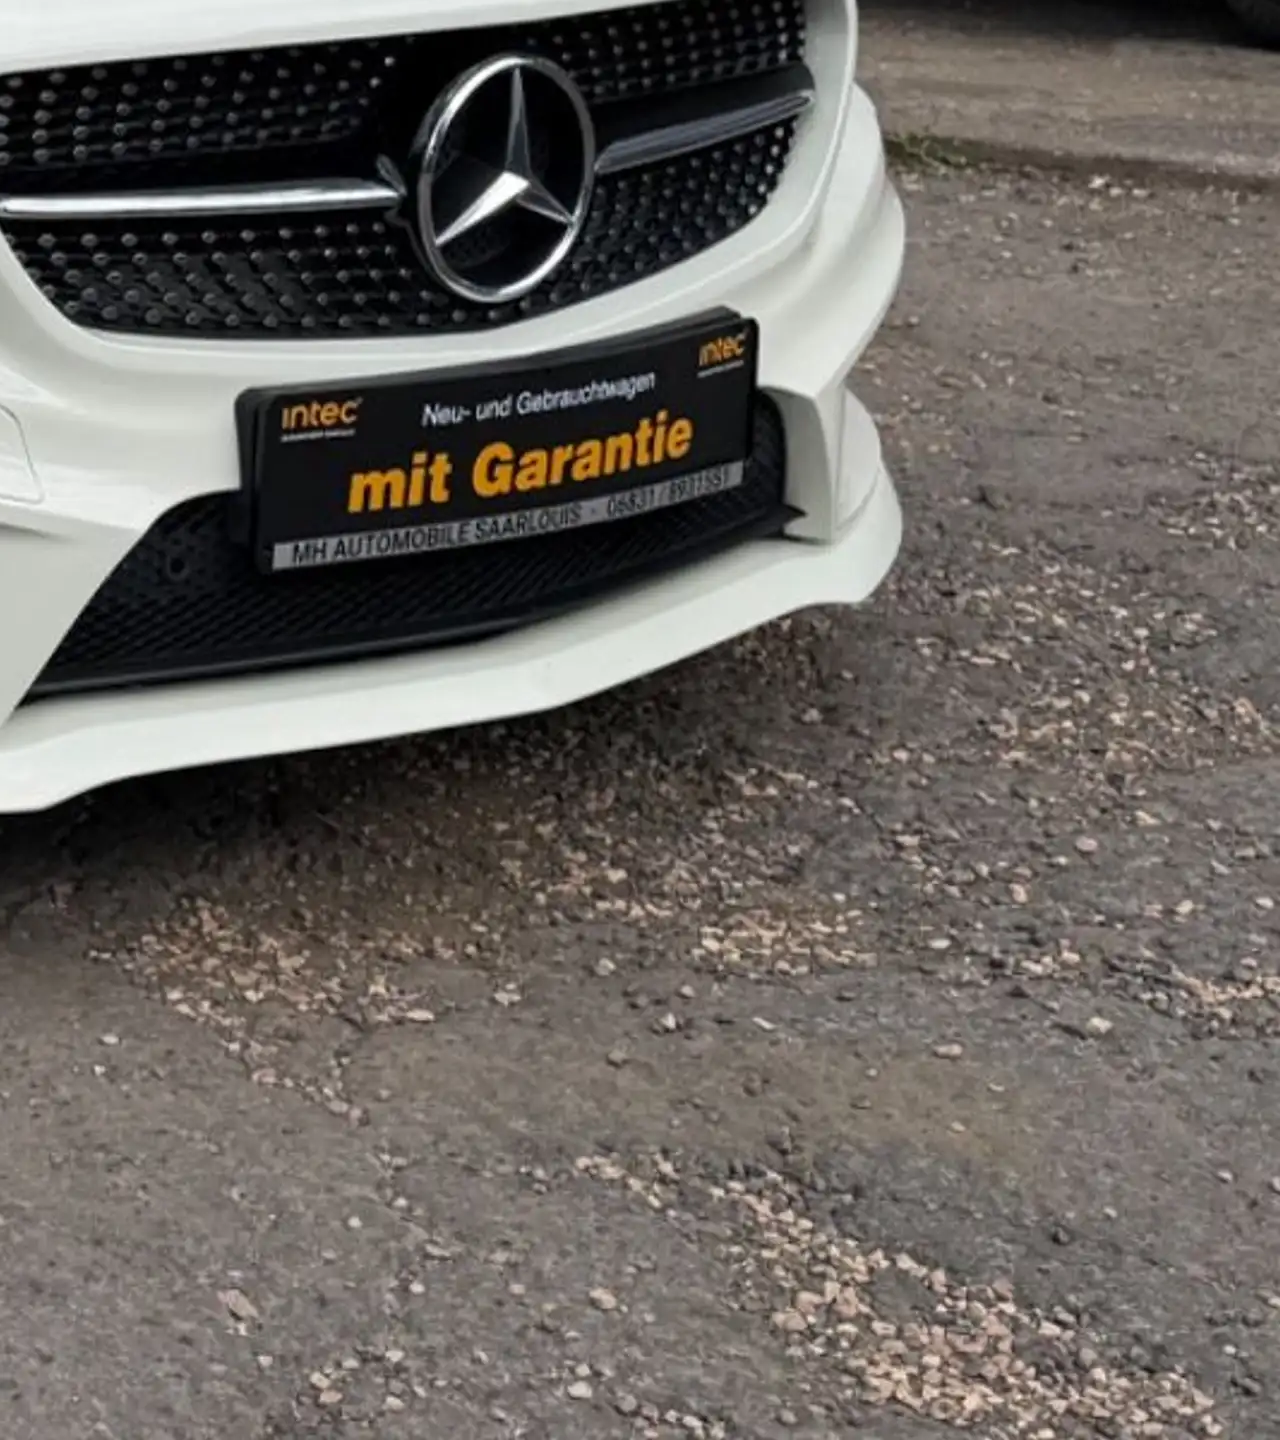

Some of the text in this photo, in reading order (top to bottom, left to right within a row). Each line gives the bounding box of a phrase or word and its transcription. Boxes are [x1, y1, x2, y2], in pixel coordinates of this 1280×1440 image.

[281, 398, 362, 429] intec
[421, 372, 656, 427] Neu- und Gebrauchtwagen
[347, 409, 693, 513] mit Garantie
[292, 542, 327, 564] MH
[334, 527, 470, 560] AUTOMOBILE
[475, 500, 582, 539] SAARLOUIS
